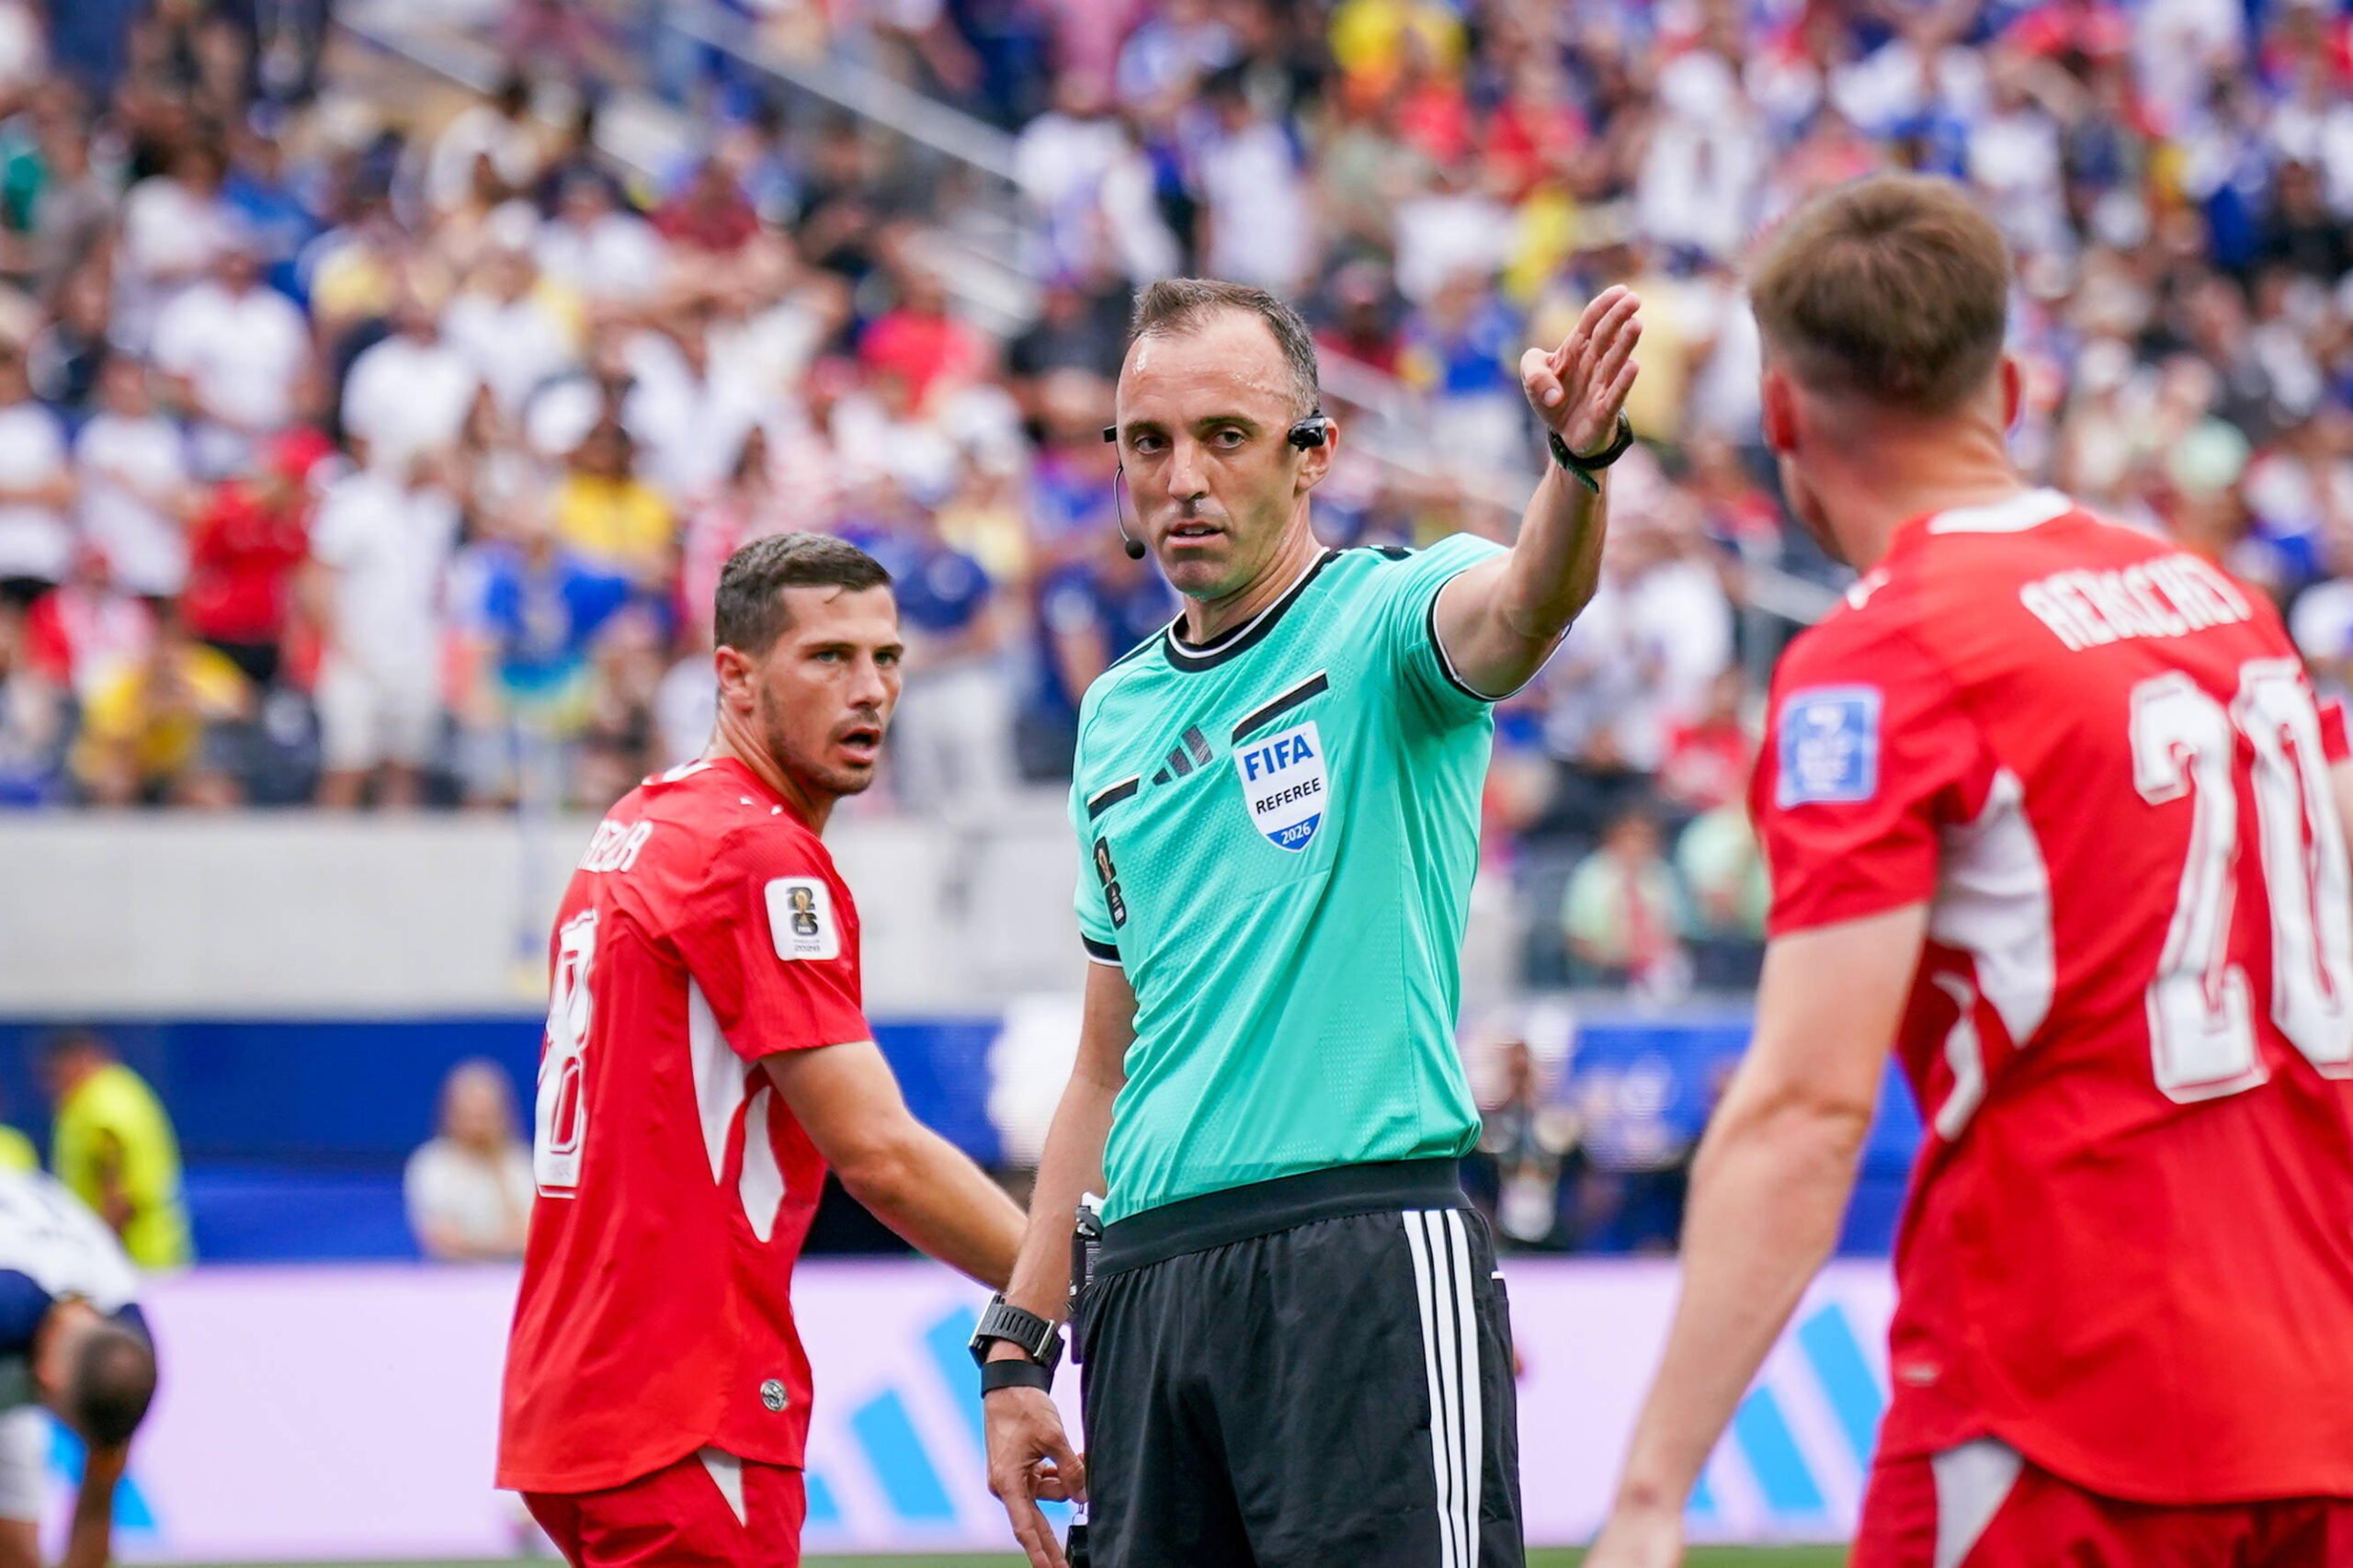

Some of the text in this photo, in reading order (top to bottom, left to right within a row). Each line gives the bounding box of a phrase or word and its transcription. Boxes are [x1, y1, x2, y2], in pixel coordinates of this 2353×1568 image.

[1244, 734, 1314, 782] FIFA
[1256, 778, 1322, 815] REFEREE
[1281, 822, 1312, 845] 2026
[2130, 657, 2353, 1103] 20
[532, 907, 599, 1198] 8
